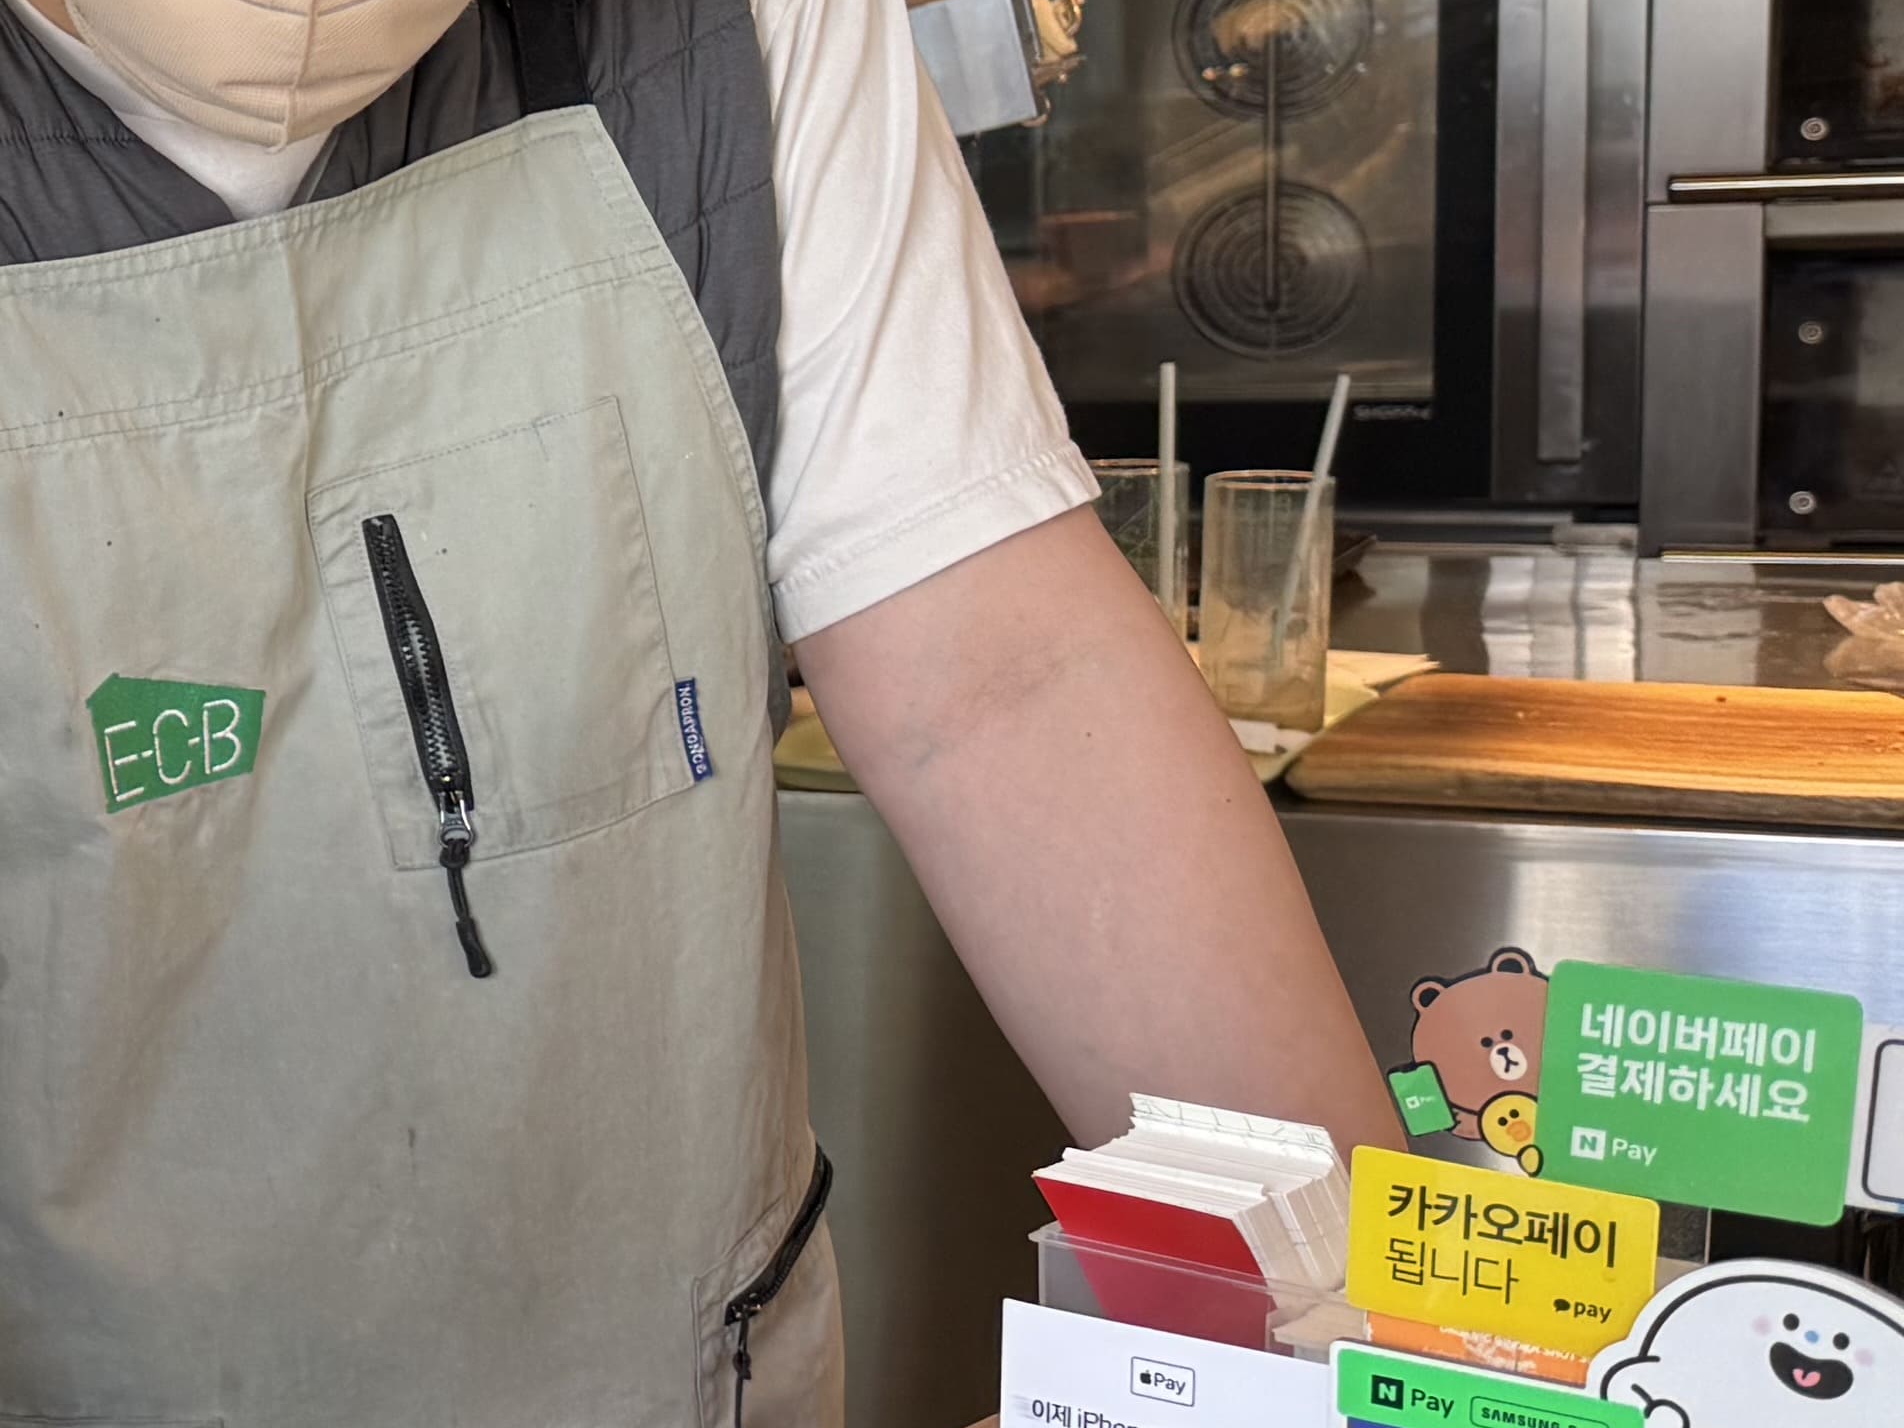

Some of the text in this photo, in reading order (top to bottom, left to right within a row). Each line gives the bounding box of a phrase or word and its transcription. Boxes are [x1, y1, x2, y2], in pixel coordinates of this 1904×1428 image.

[1580, 1003, 1817, 1074] 네이버페이
[1577, 1052, 1811, 1123] 결제하세요
[1612, 1137, 1658, 1167] Pay
[1386, 1183, 1618, 1270] 카카오페이
[1385, 1237, 1521, 1305] 됩니다
[1573, 1300, 1612, 1324] pay
[1154, 1371, 1187, 1396] Pay
[1411, 1389, 1455, 1420] Pay
